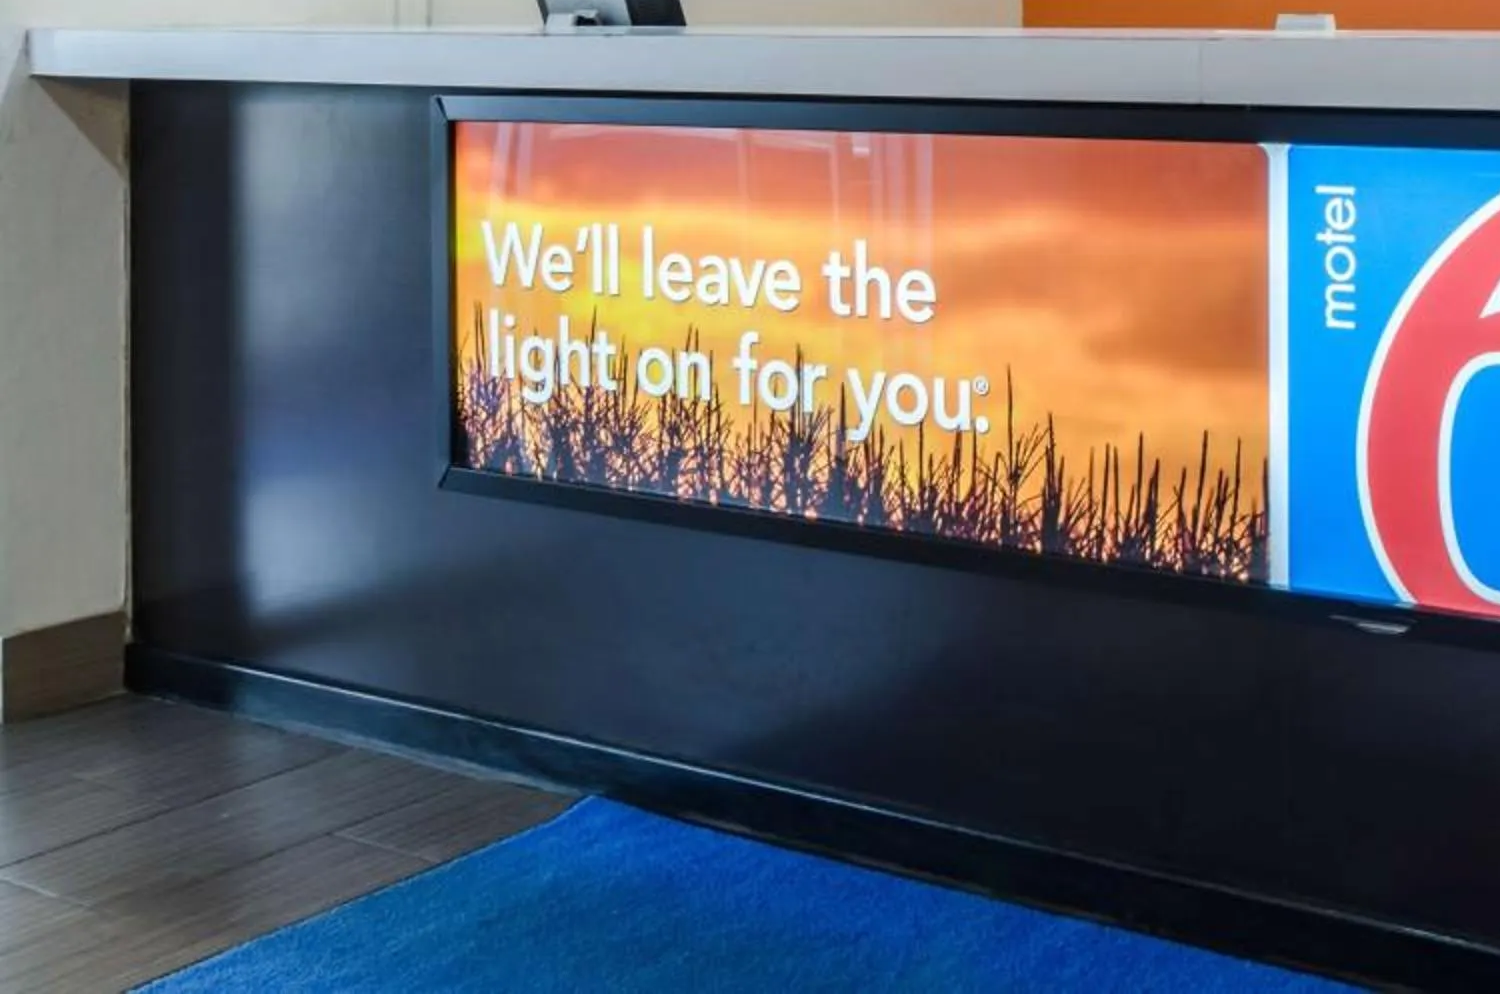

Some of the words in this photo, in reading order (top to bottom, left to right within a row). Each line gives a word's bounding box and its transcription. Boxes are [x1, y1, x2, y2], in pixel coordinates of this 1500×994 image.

[481, 220, 620, 296] We'll
[642, 225, 801, 310] leave
[821, 239, 936, 323] the
[1316, 185, 1356, 329] motel
[488, 308, 617, 404] light
[637, 347, 713, 401] on
[732, 331, 827, 414] for
